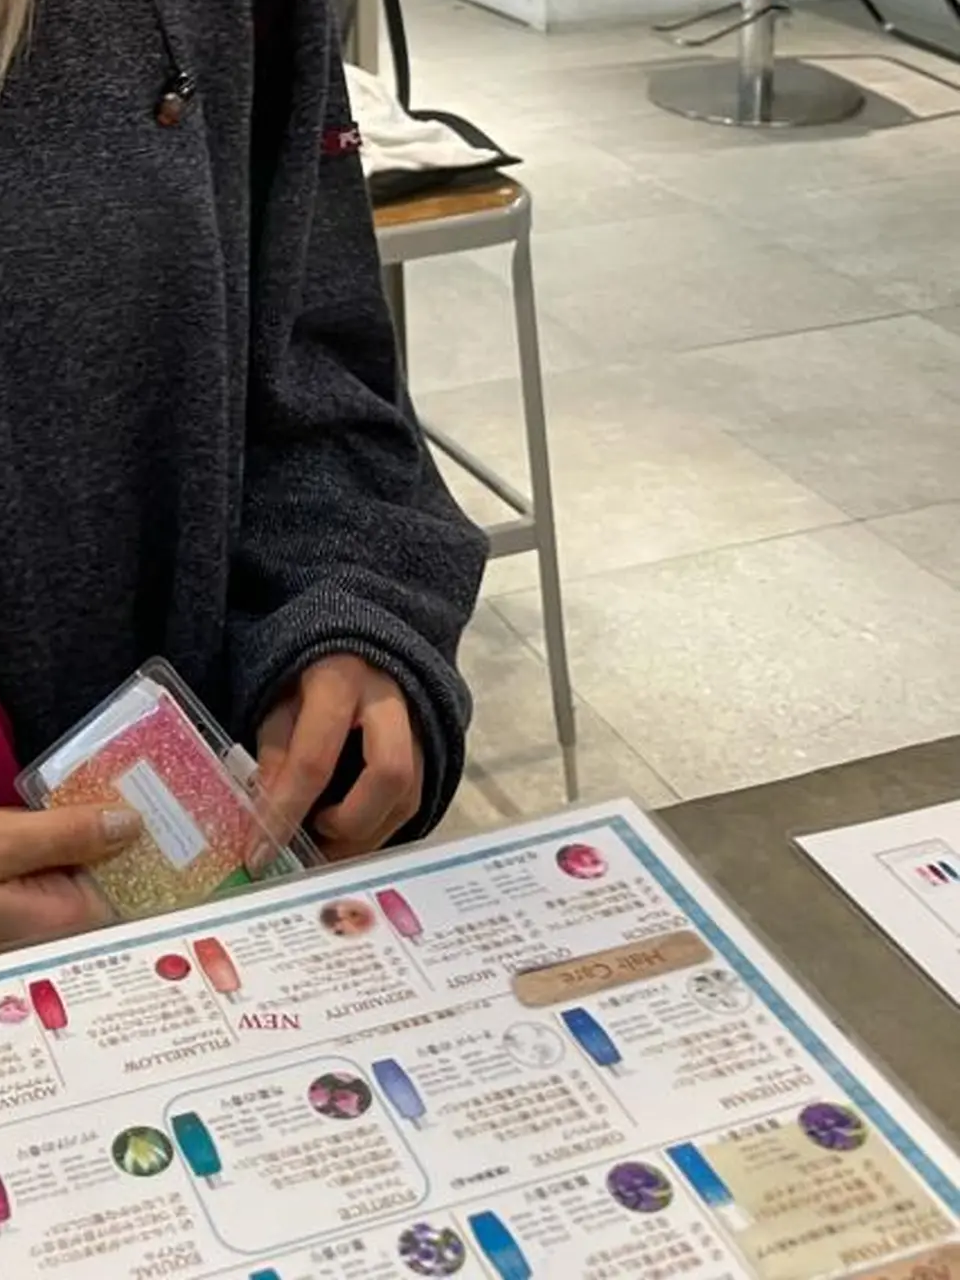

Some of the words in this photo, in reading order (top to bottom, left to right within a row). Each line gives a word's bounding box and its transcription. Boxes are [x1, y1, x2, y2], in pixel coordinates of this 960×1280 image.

[614, 945, 665, 975] Hair
[557, 960, 613, 991] Care
[238, 1010, 302, 1032] NEW
